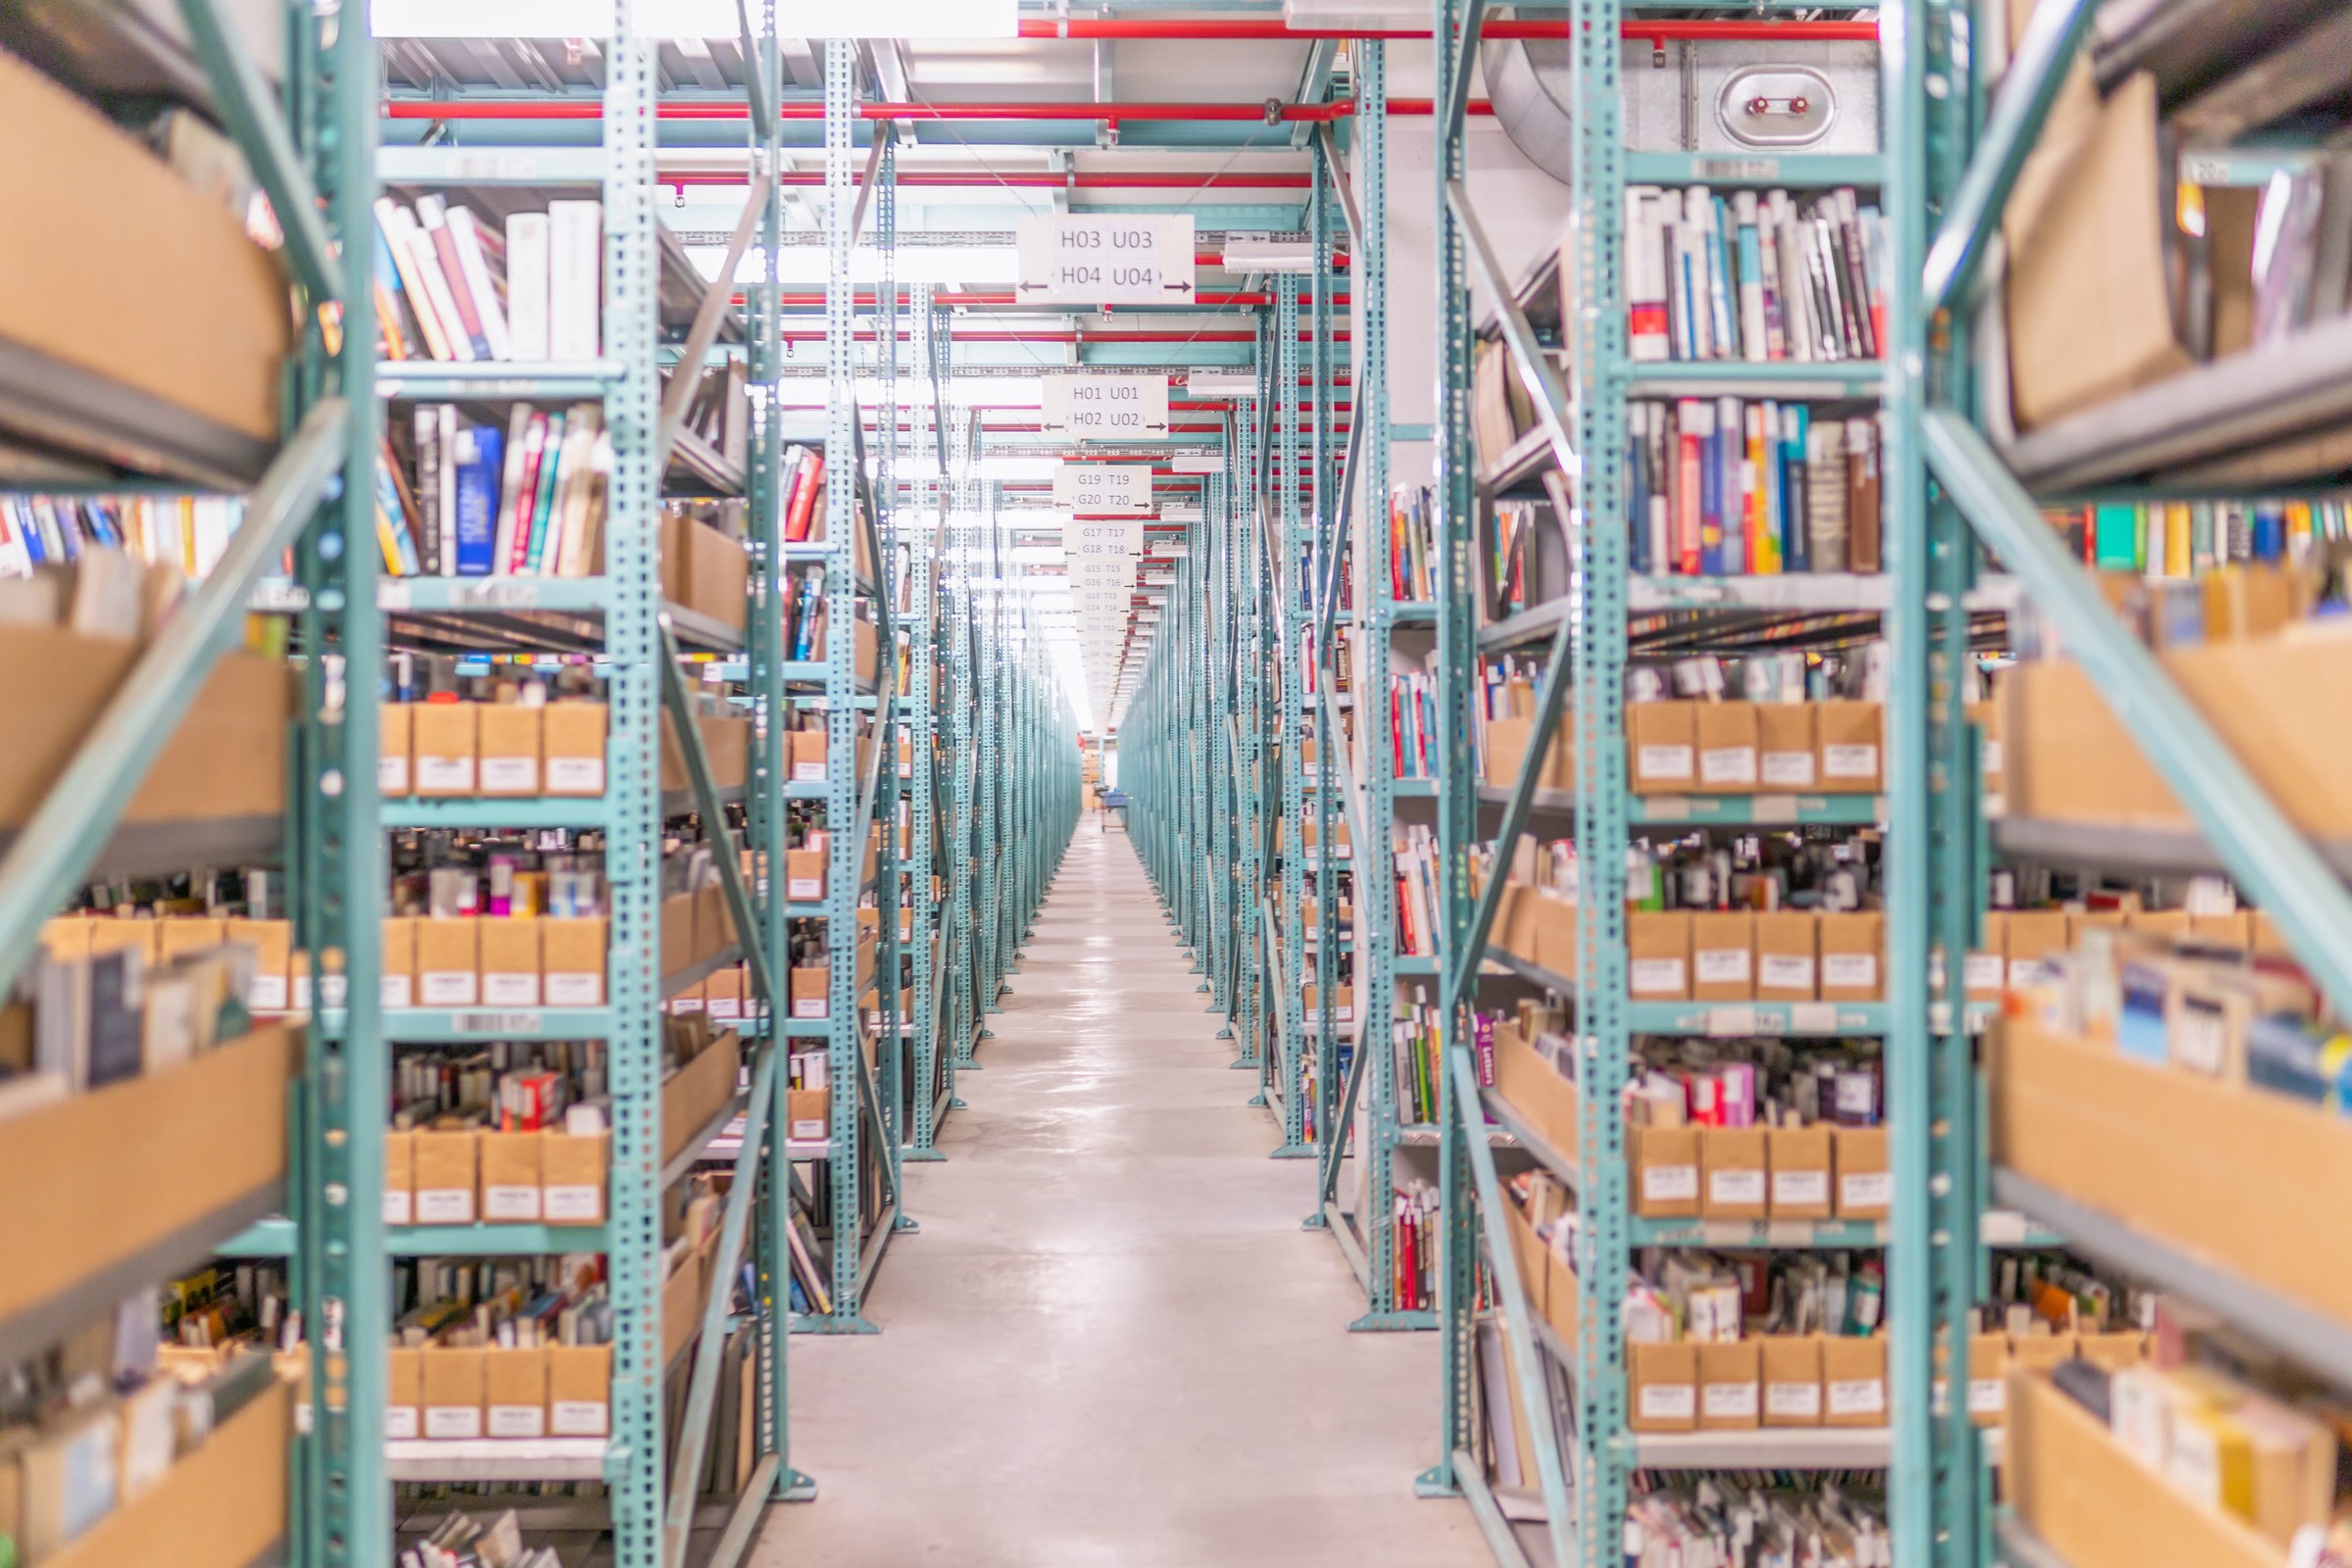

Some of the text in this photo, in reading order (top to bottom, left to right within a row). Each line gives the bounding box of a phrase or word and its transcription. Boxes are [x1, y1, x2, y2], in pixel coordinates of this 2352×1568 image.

[1061, 230, 1152, 249] H03 U03
[1061, 267, 1153, 286] H04 U04
[1073, 386, 1139, 400] H01 U01
[1073, 412, 1139, 426] H02 U02
[1078, 474, 1130, 485] G19 T19
[1078, 494, 1130, 506] G20 T20
[1082, 528, 1125, 537] G17 T17
[1082, 544, 1125, 555] G18 T18
[1084, 578, 1102, 587] G16
